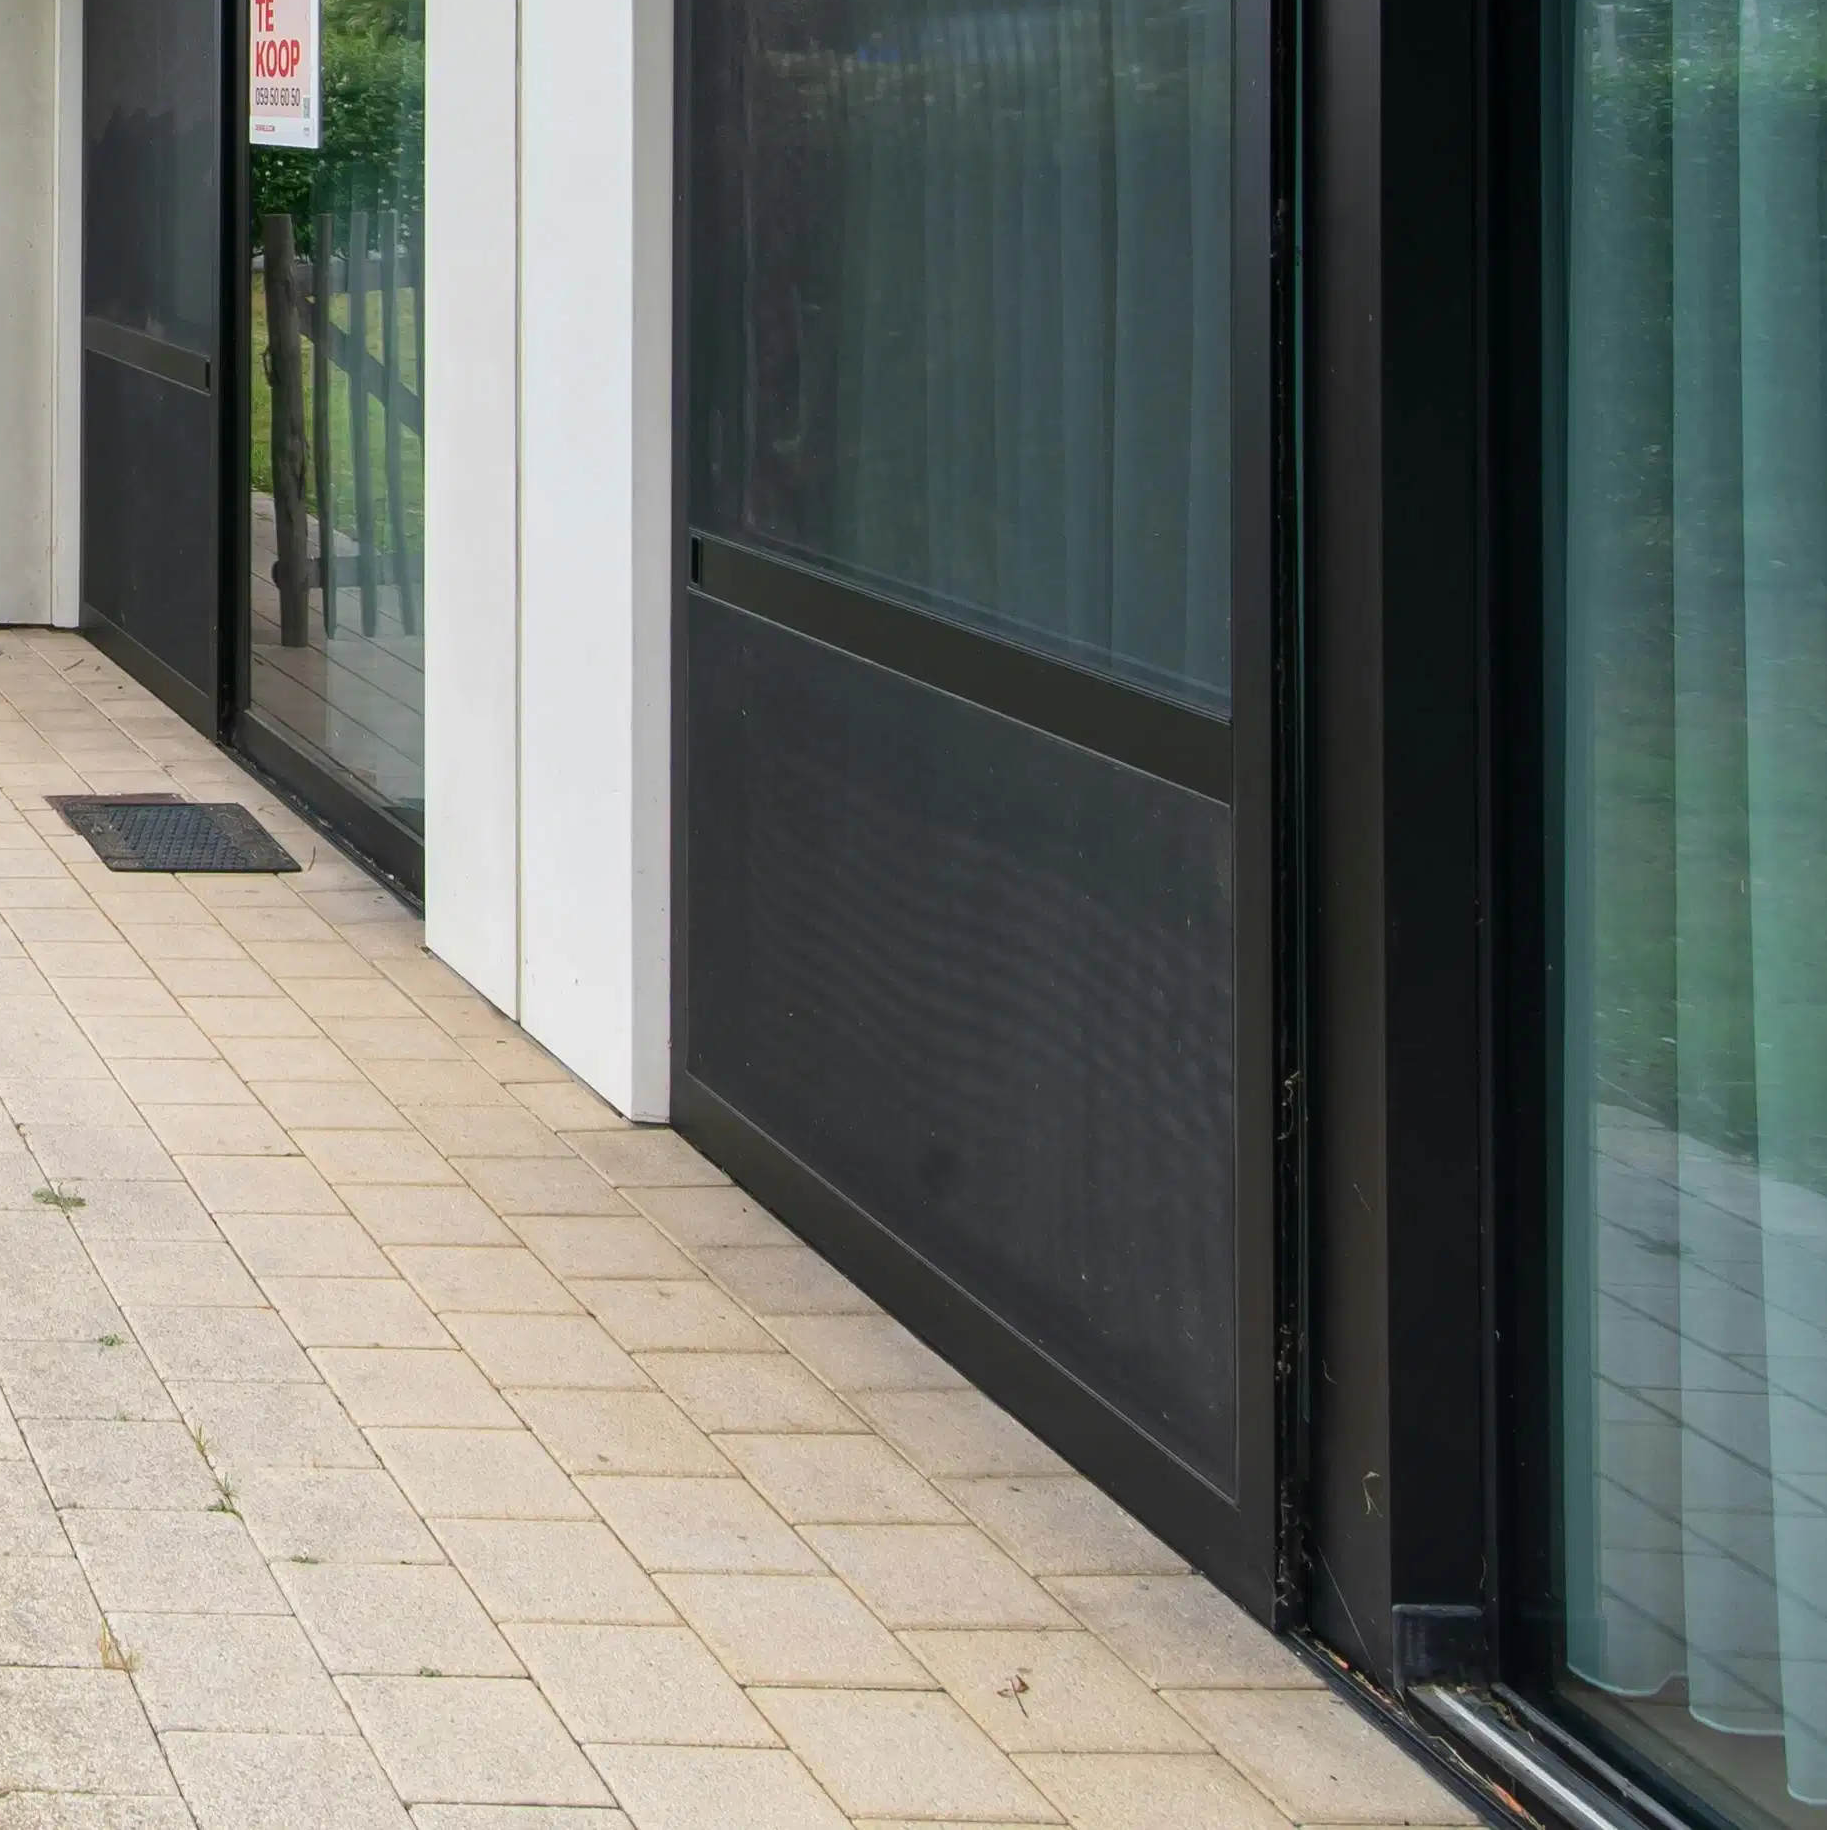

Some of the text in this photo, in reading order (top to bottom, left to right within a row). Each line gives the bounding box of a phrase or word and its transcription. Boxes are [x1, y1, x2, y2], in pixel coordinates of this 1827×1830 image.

[256, 39, 301, 78] KOOP
[270, 87, 279, 106] 50
[280, 87, 290, 106] 60
[291, 87, 300, 107] 50
